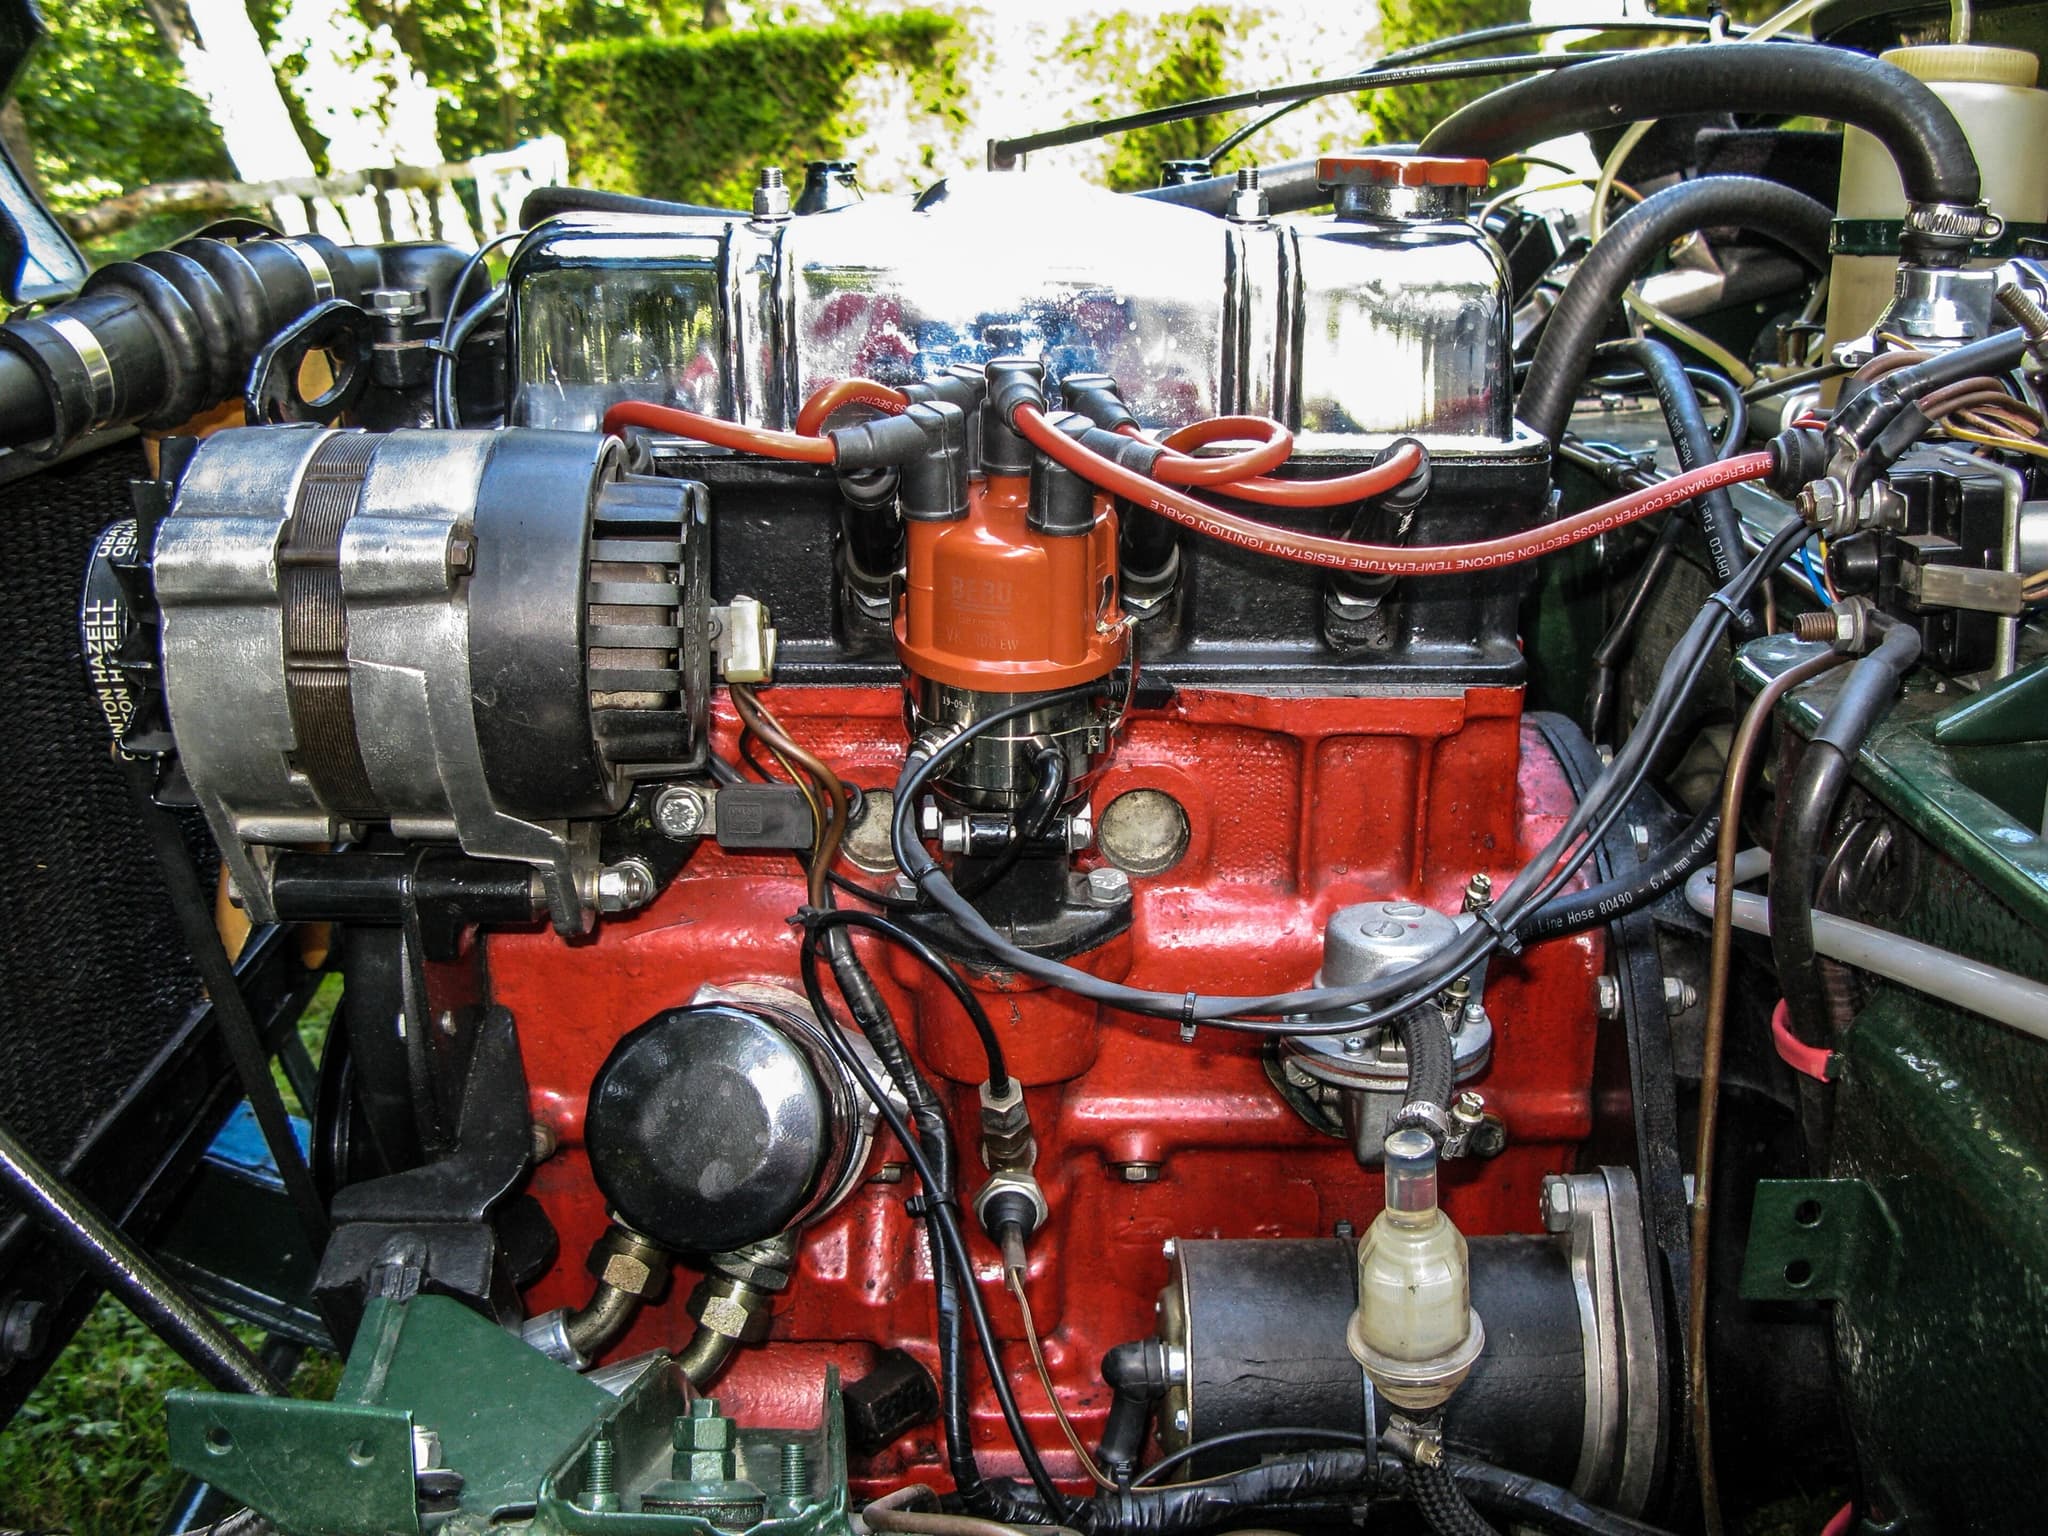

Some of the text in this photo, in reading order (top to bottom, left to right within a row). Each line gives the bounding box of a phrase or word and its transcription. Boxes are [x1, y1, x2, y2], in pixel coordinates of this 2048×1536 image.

[1680, 437, 1694, 466] Hose
[1665, 464, 1754, 502] PERFORMANCE
[1149, 498, 1197, 526] CABLE
[1615, 497, 1664, 523] COPPER
[1699, 500, 1716, 533] Fuel
[1198, 520, 1264, 549] IGNITION
[1517, 530, 1570, 558] SECTION
[1573, 518, 1614, 541] CROSS
[1266, 543, 1346, 566] RESISTANT
[1350, 558, 1451, 572] TEMPERATURE
[1456, 551, 1515, 569] SILICONE
[1709, 536, 1730, 578] DAYCO
[951, 575, 1013, 604] BERU
[86, 599, 109, 683] HAZELL
[102, 598, 125, 682] HZELL
[942, 695, 975, 711] 19-09-11
[1566, 908, 1595, 925] Hose
[1599, 891, 1633, 915] 80490
[1673, 856, 1690, 873] mm
